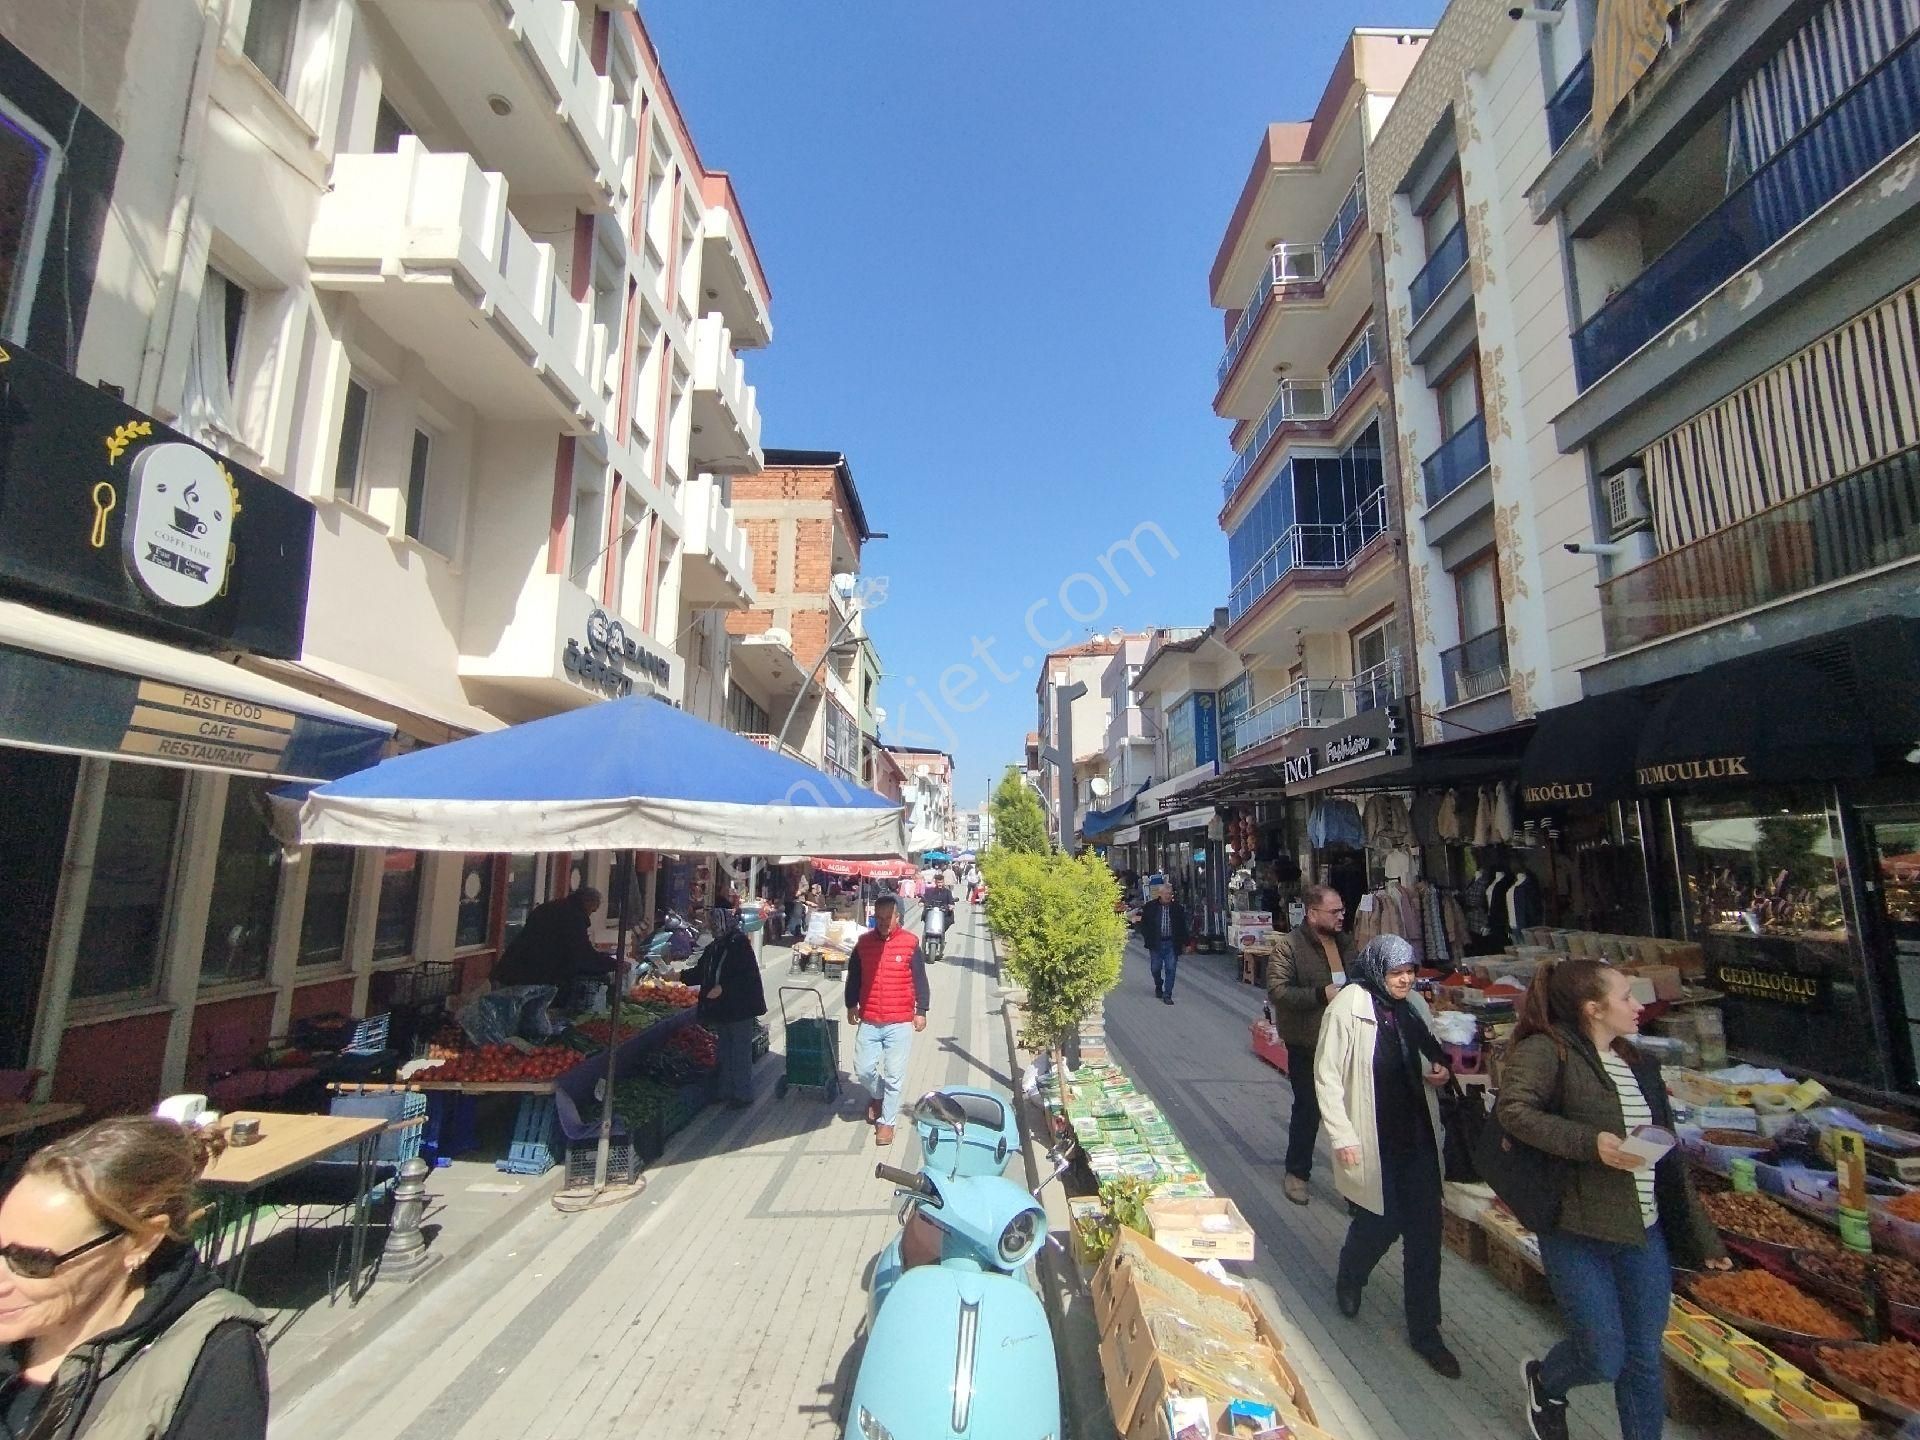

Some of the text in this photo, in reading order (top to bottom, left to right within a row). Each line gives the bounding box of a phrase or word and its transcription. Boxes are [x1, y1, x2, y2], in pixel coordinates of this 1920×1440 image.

[183, 692, 262, 720] FAST FOOD
[199, 722, 238, 739] CAFE
[158, 739, 254, 764] RESTAURANT
[1326, 735, 1370, 763] Fashion
